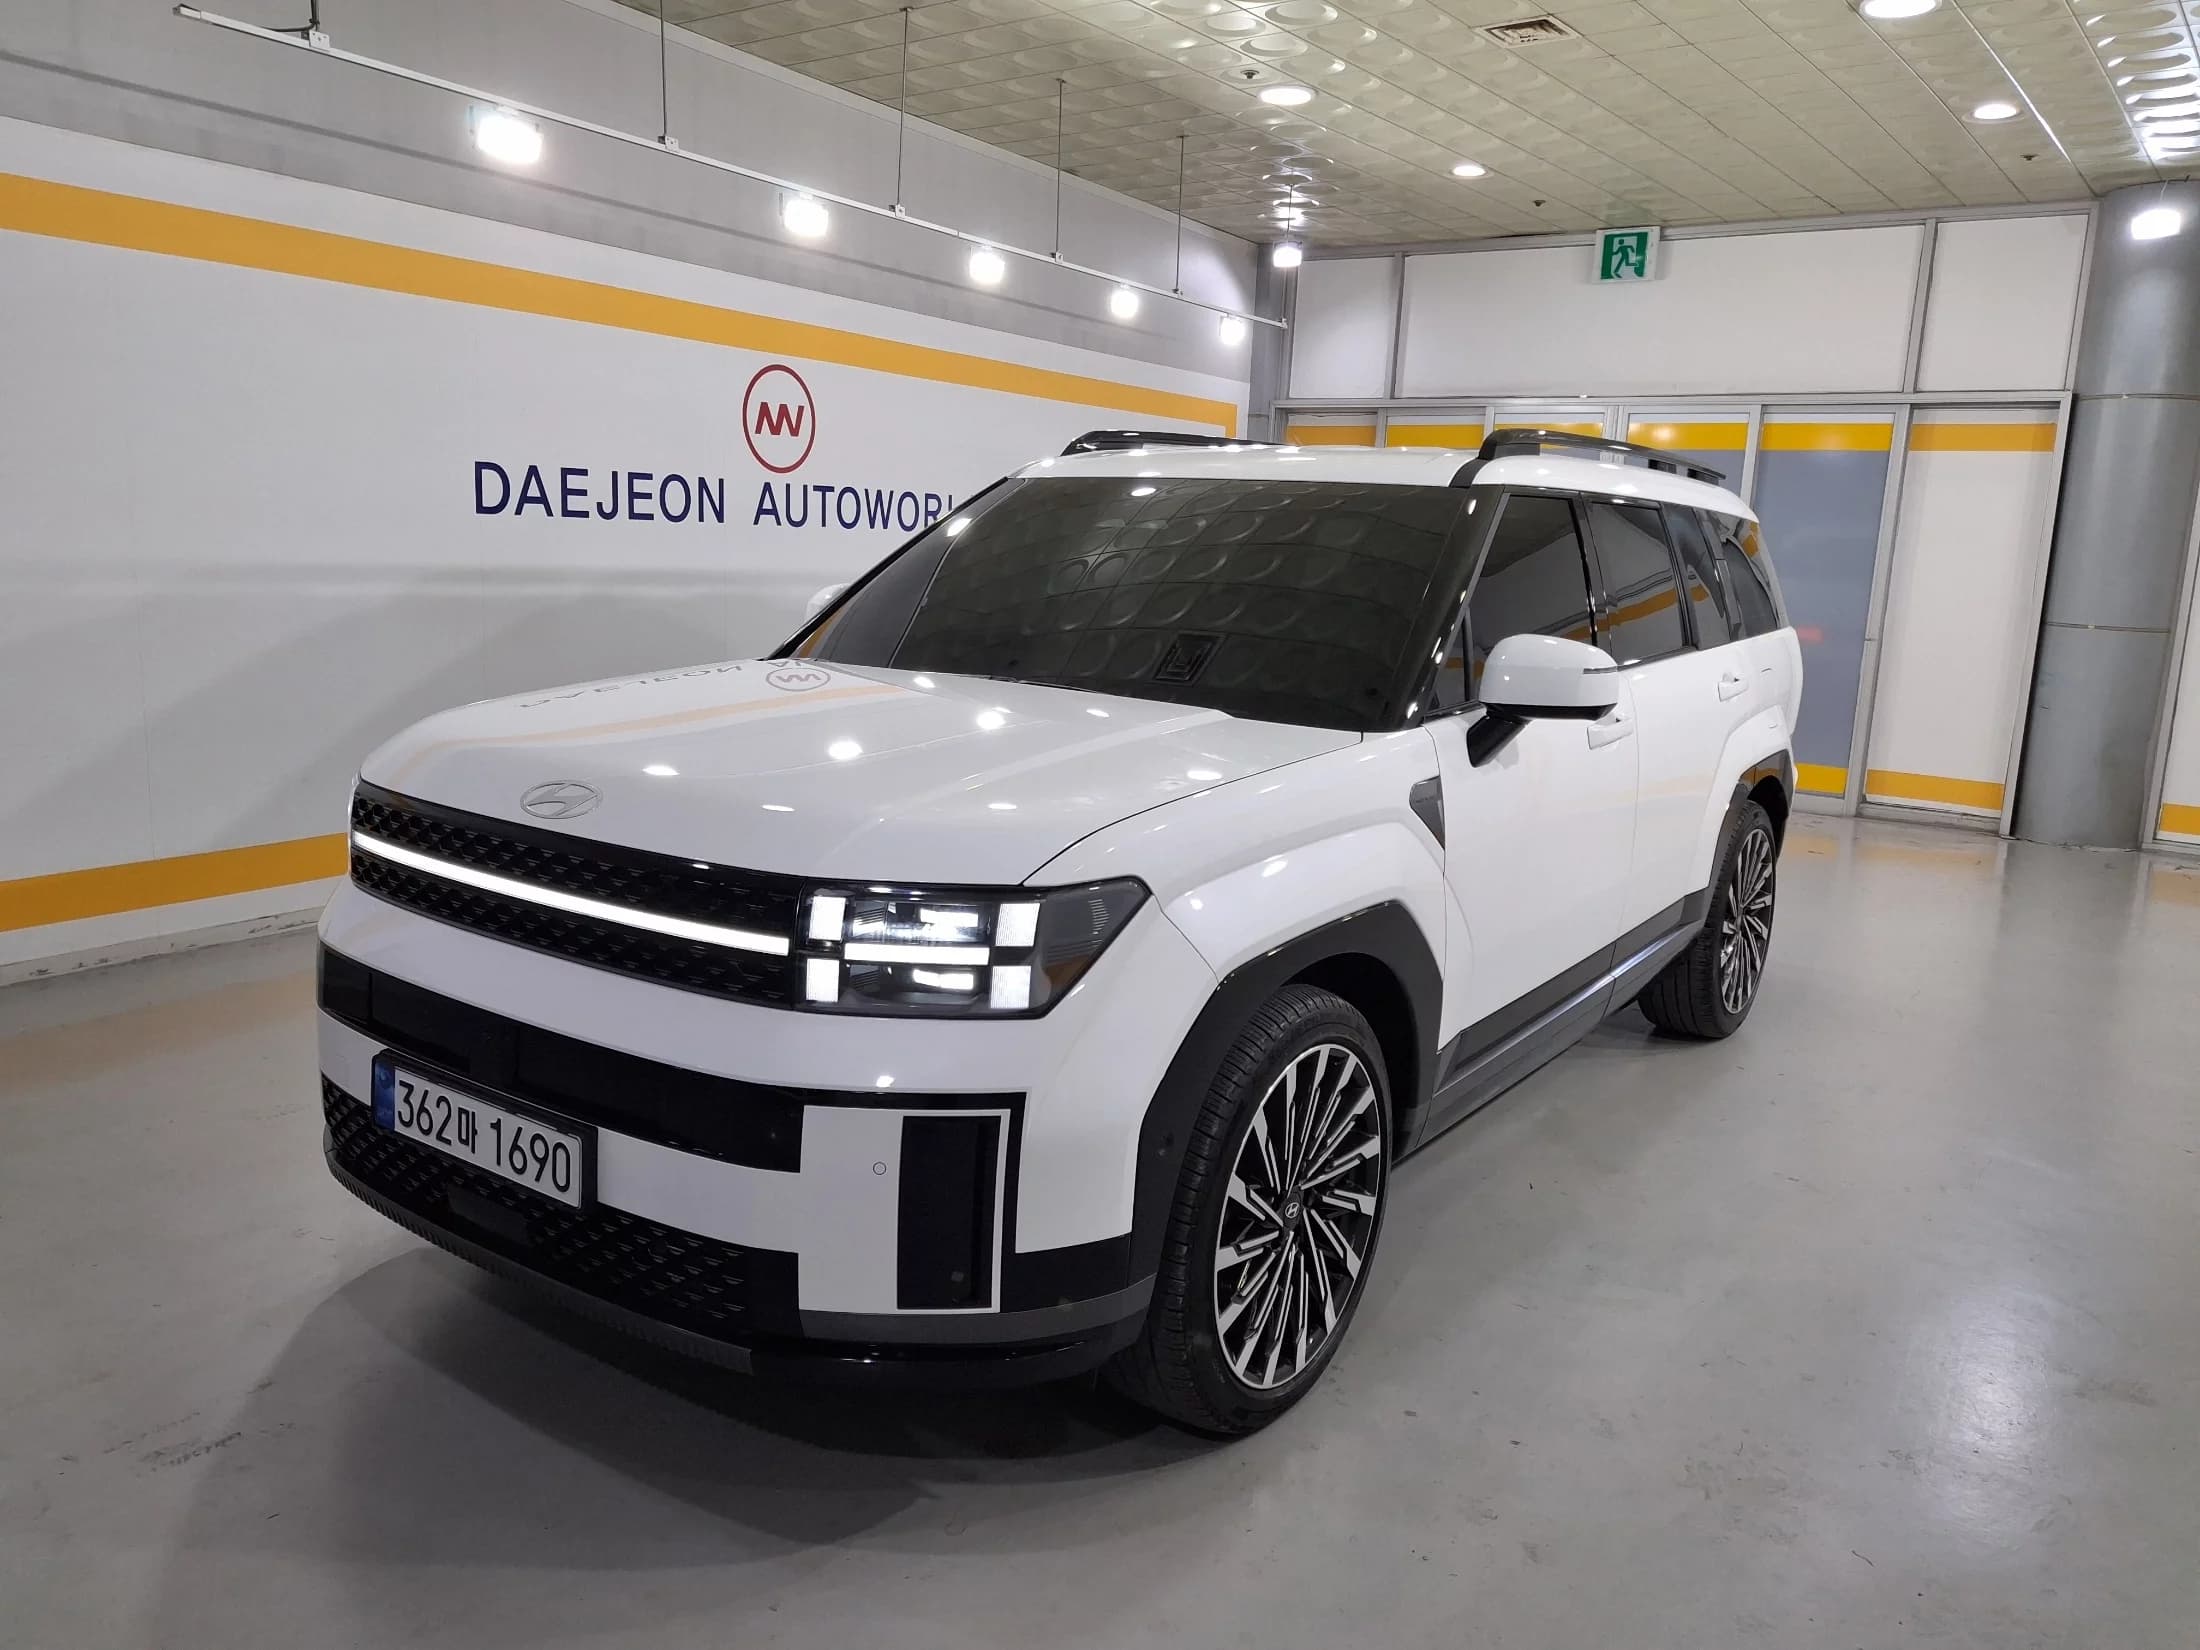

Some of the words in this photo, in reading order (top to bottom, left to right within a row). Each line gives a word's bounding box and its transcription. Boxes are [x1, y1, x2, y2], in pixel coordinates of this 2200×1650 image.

[474, 460, 725, 524] DAEJEON
[398, 1080, 478, 1154] 362마
[490, 1117, 571, 1193] 1690
